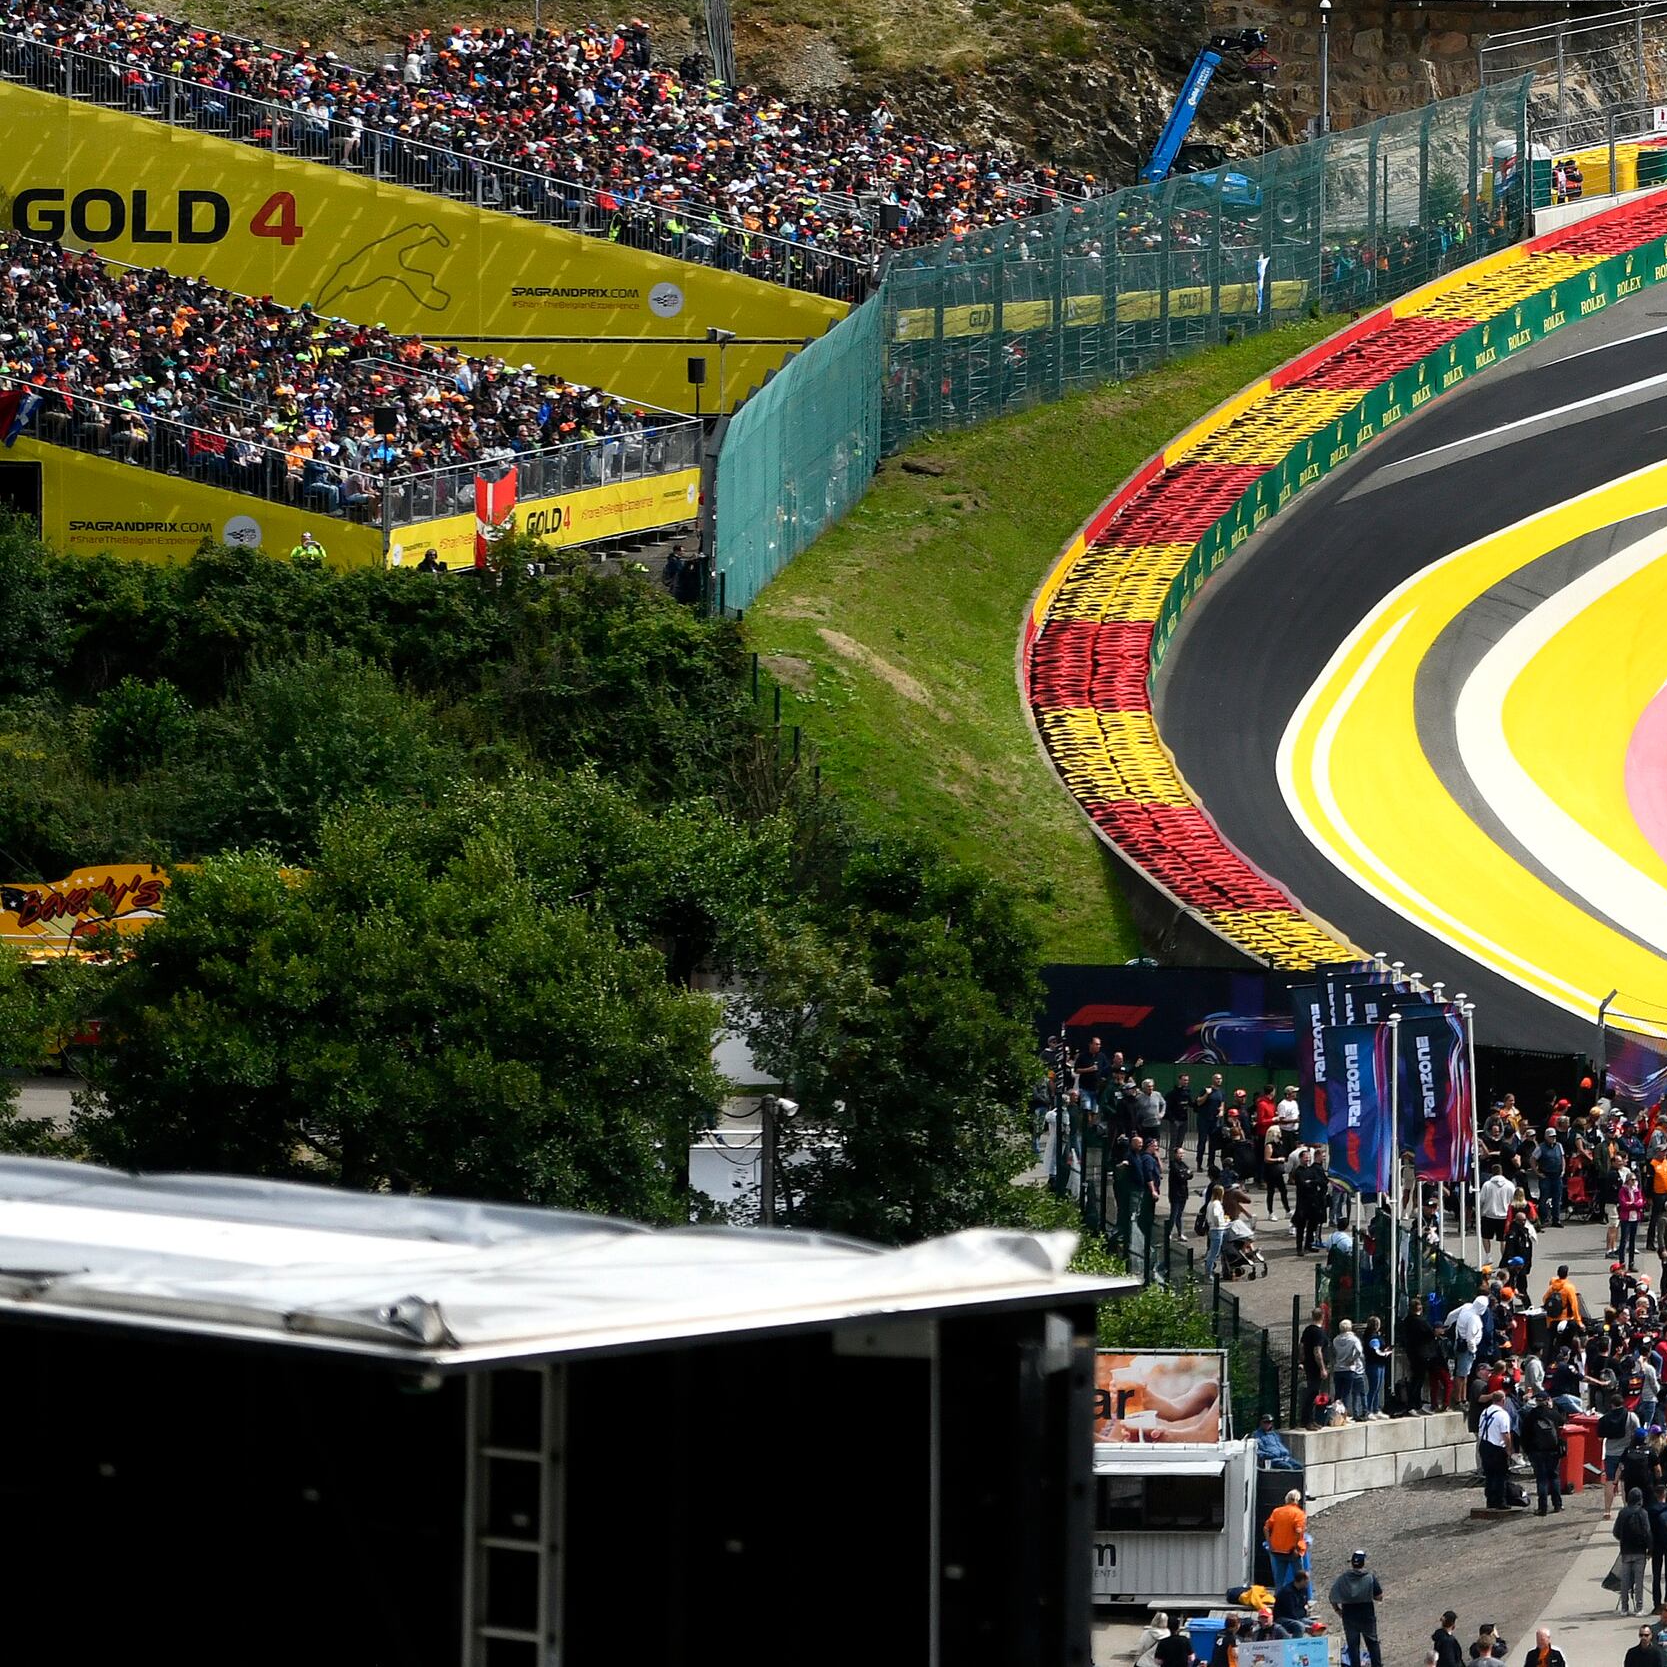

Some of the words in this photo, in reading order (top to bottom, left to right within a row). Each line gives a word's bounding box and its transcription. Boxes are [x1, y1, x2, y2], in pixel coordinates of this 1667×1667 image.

[12, 189, 230, 243] GOLD
[250, 191, 303, 245] 4
[512, 287, 640, 298] SPAGRANDPRIX.COM
[1617, 276, 1641, 297] ROLEX
[1581, 293, 1606, 315] ROLEX
[1544, 311, 1565, 333] ROLEX
[1508, 329, 1531, 351] ROLEX
[1475, 347, 1496, 369] ROLEX
[1443, 365, 1463, 388] ROLEX
[70, 521, 213, 533] SPAGRANDPRIX.COM
[526, 507, 562, 536] GOLD
[563, 505, 571, 530] 4
